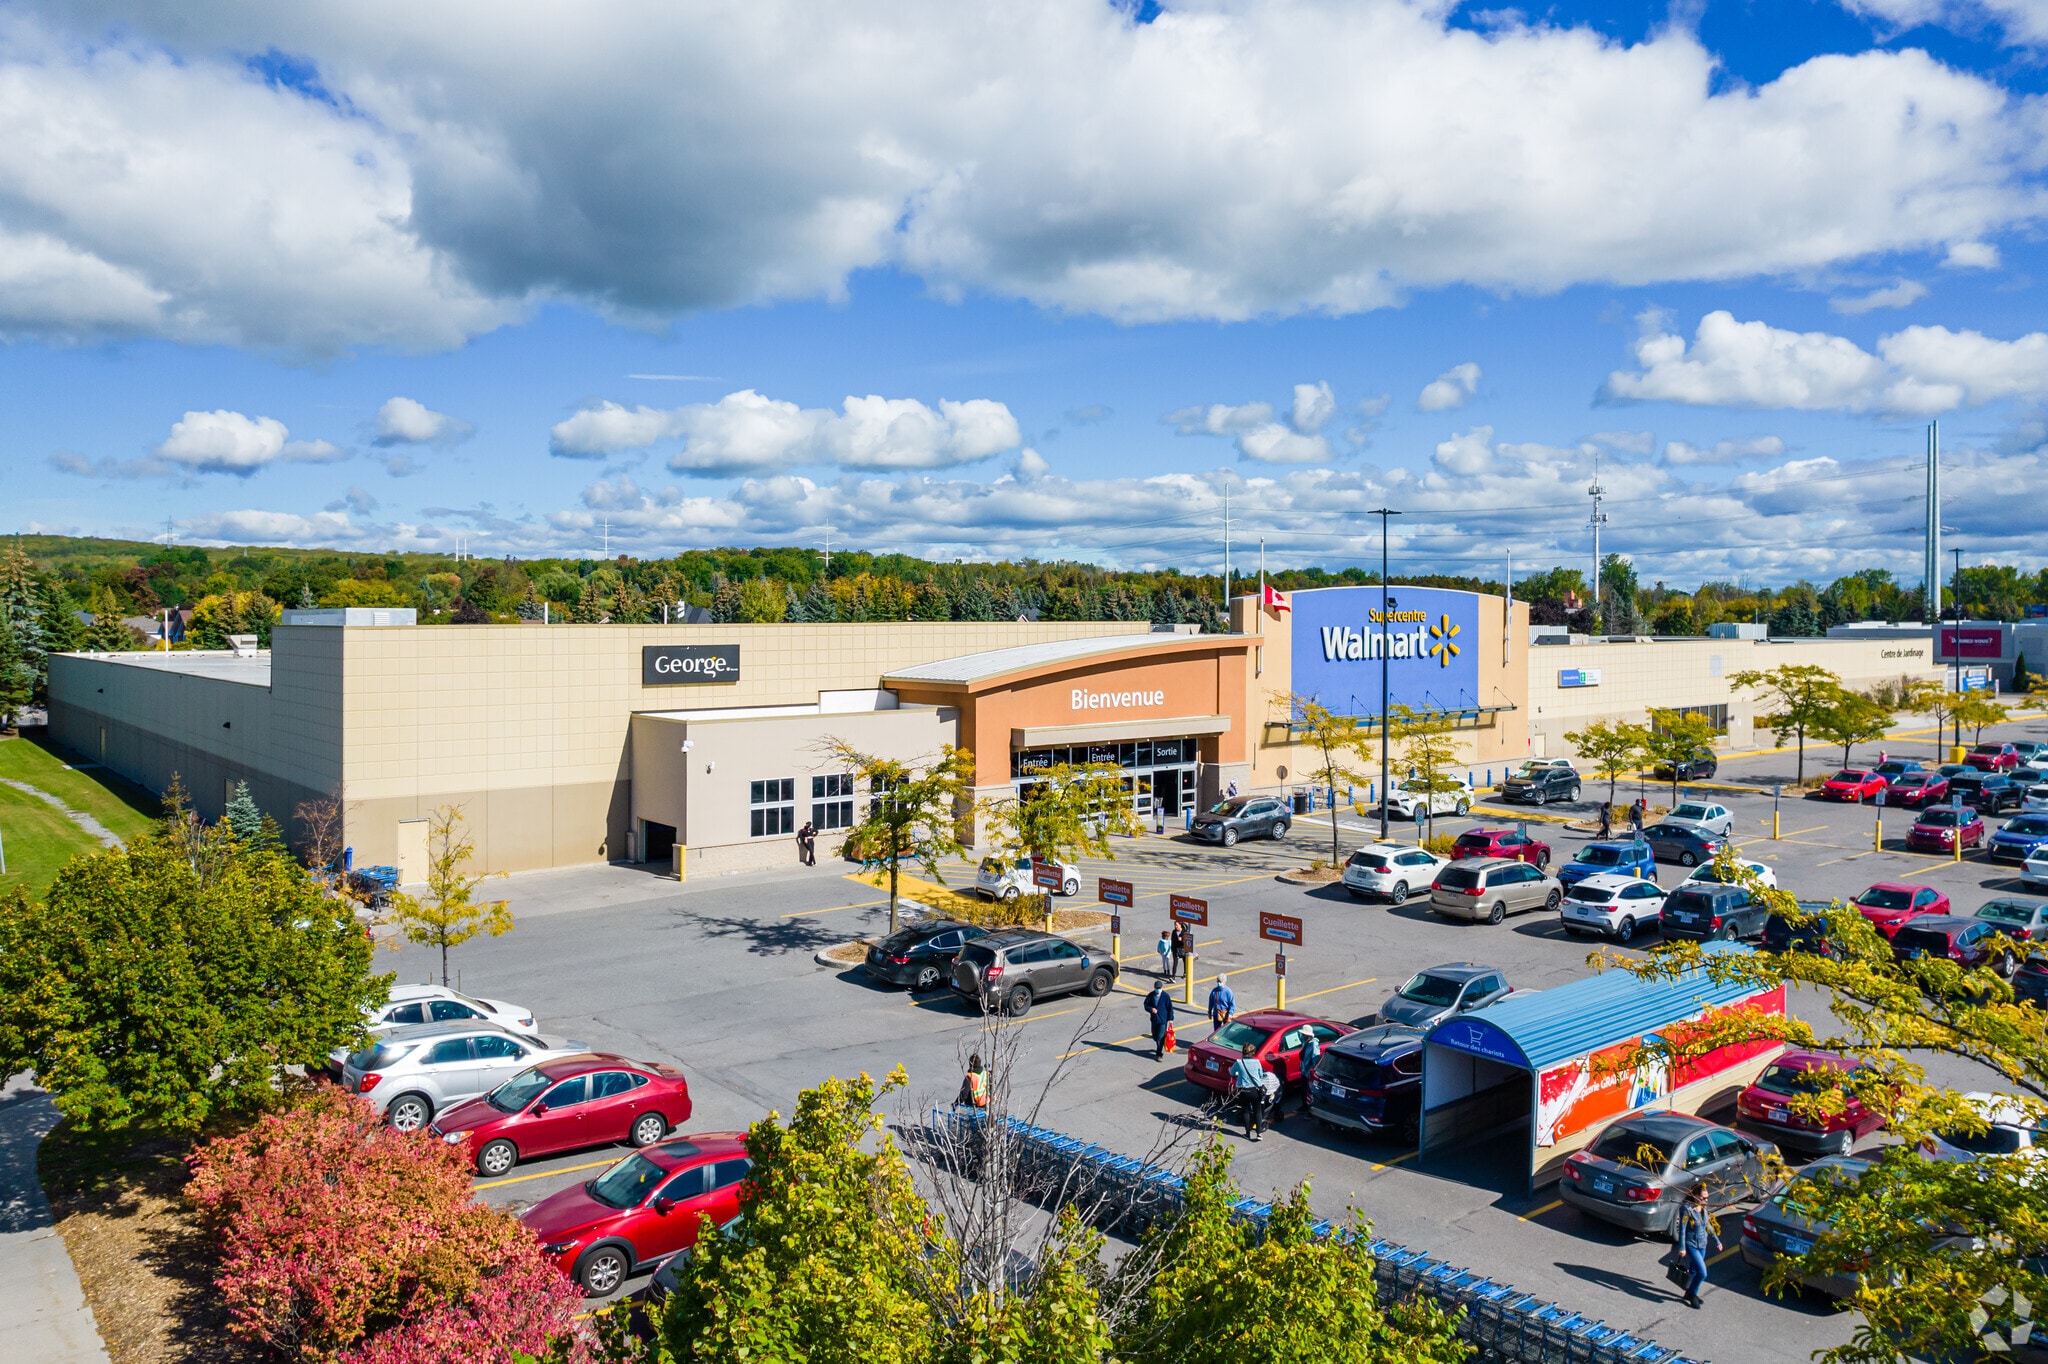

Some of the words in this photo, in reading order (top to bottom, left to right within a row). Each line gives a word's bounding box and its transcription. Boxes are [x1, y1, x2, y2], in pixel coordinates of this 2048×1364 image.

[1322, 625, 1428, 660] Walmart
[1881, 649, 1896, 659] Centre
[1071, 688, 1164, 710] Bienvenue
[1091, 752, 1115, 762] Entrée
[1157, 747, 1178, 757] Sortie
[1101, 882, 1131, 895] Cueillette
[1172, 899, 1205, 912] Cueillette
[1263, 916, 1299, 931] Cueillette
[1450, 1038, 1470, 1050] Retour
[1470, 1043, 1480, 1052] des
[1481, 1046, 1505, 1058] chariots
